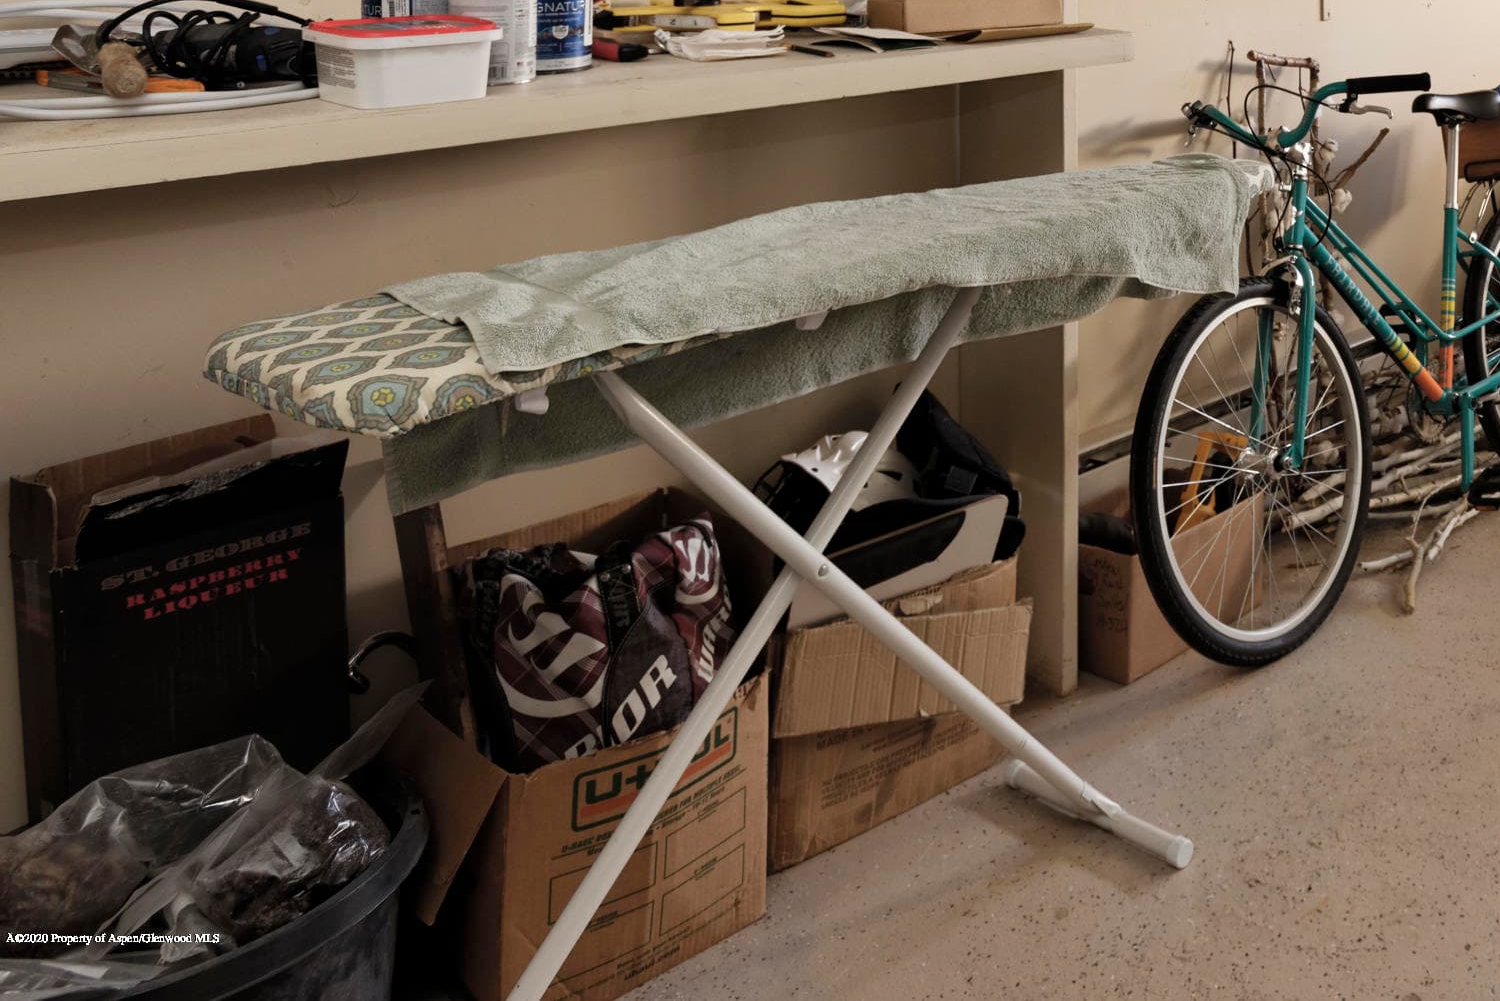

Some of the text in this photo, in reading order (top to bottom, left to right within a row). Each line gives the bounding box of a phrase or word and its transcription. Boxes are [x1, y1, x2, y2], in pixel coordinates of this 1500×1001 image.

[1327, 253, 1382, 326] FAIRDALE
[101, 522, 312, 591] ST. GEORGE
[126, 547, 304, 609] RASPBERRY
[144, 567, 289, 620] LIQUEUR
